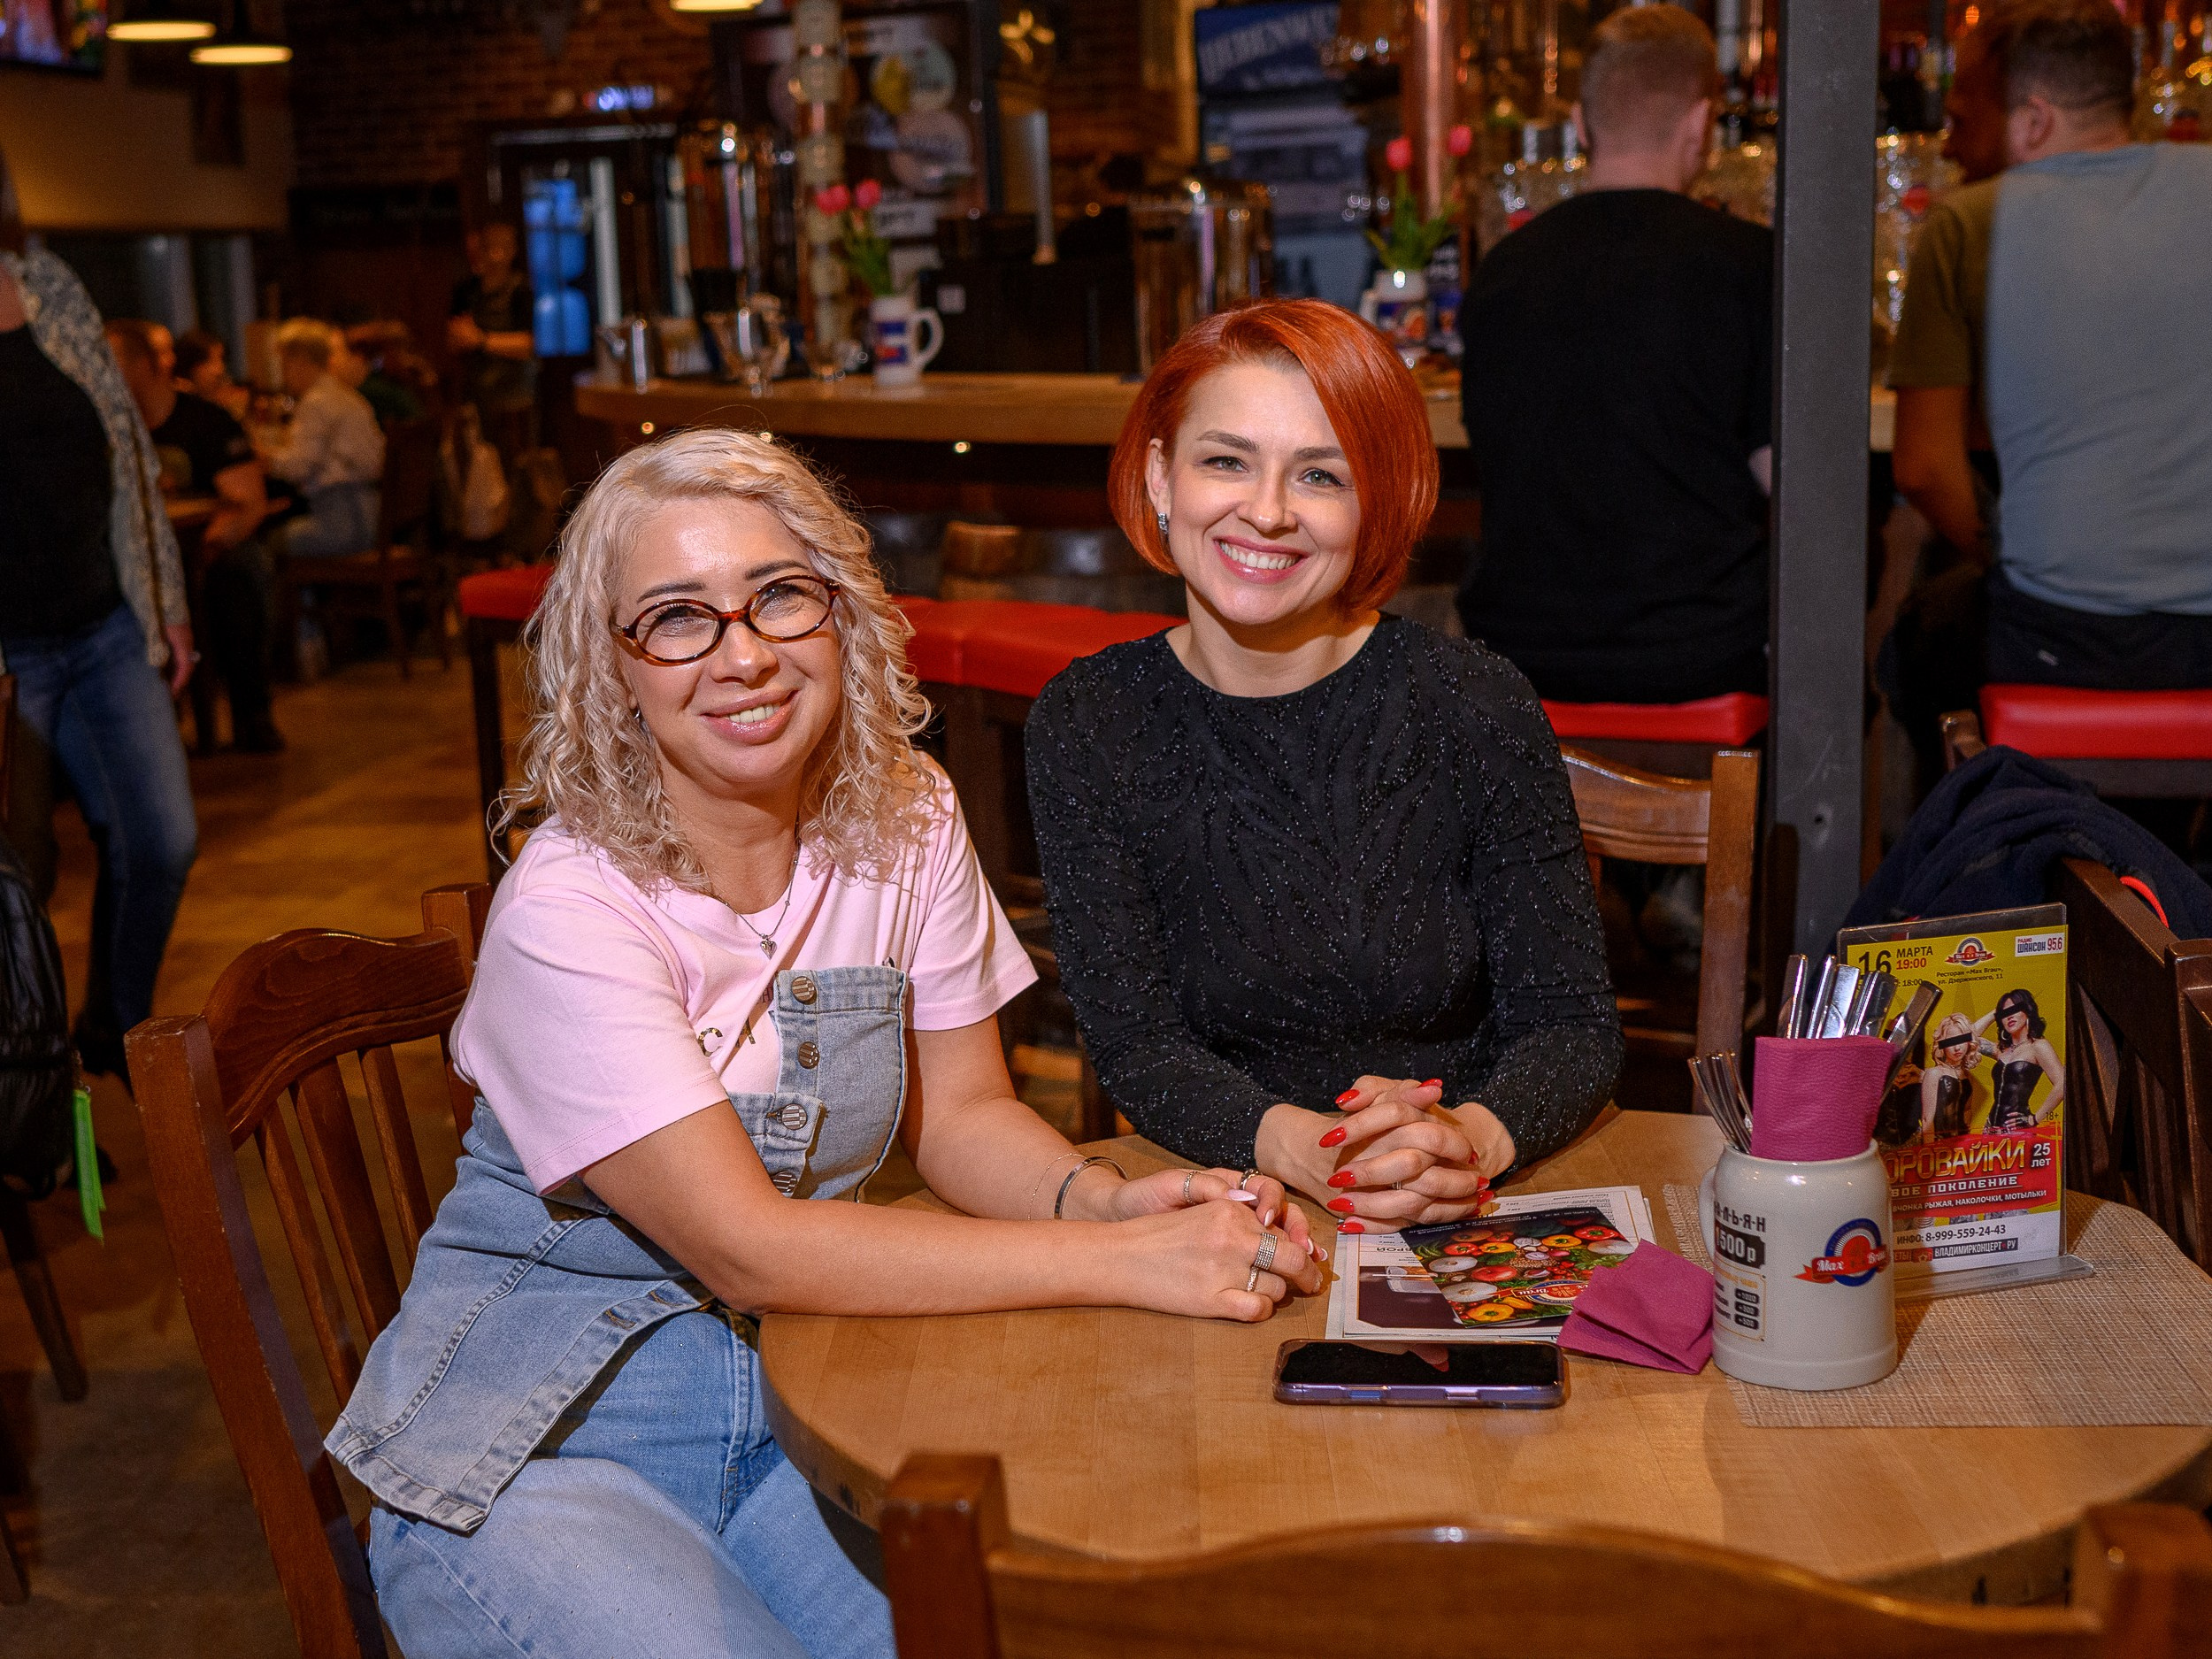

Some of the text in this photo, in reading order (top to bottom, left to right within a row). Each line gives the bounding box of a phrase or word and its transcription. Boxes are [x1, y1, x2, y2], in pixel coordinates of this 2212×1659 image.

[1896, 946, 1933, 958] МАРТА
[2017, 941, 2047, 953] ШАНСОН
[1858, 949, 1892, 979] 16
[1896, 957, 1927, 970] 19:00
[1902, 978, 1923, 987] 18:00
[2045, 1111, 2059, 1121] 18+
[2033, 1143, 2050, 1156] 25
[2031, 1157, 2052, 1168] лет
[1927, 1176, 2017, 1194] ПОКОЛЕНИЕ
[1924, 1200, 1954, 1209] РЫЖАЯ,
[1955, 1194, 2003, 1206] НАКОЛОЧКИ,
[2005, 1190, 2047, 1201] МОТЫЛЬКИ
[1896, 1234, 1924, 1245] ИНФО:
[1925, 1224, 2007, 1242] 8-999-559-24-43
